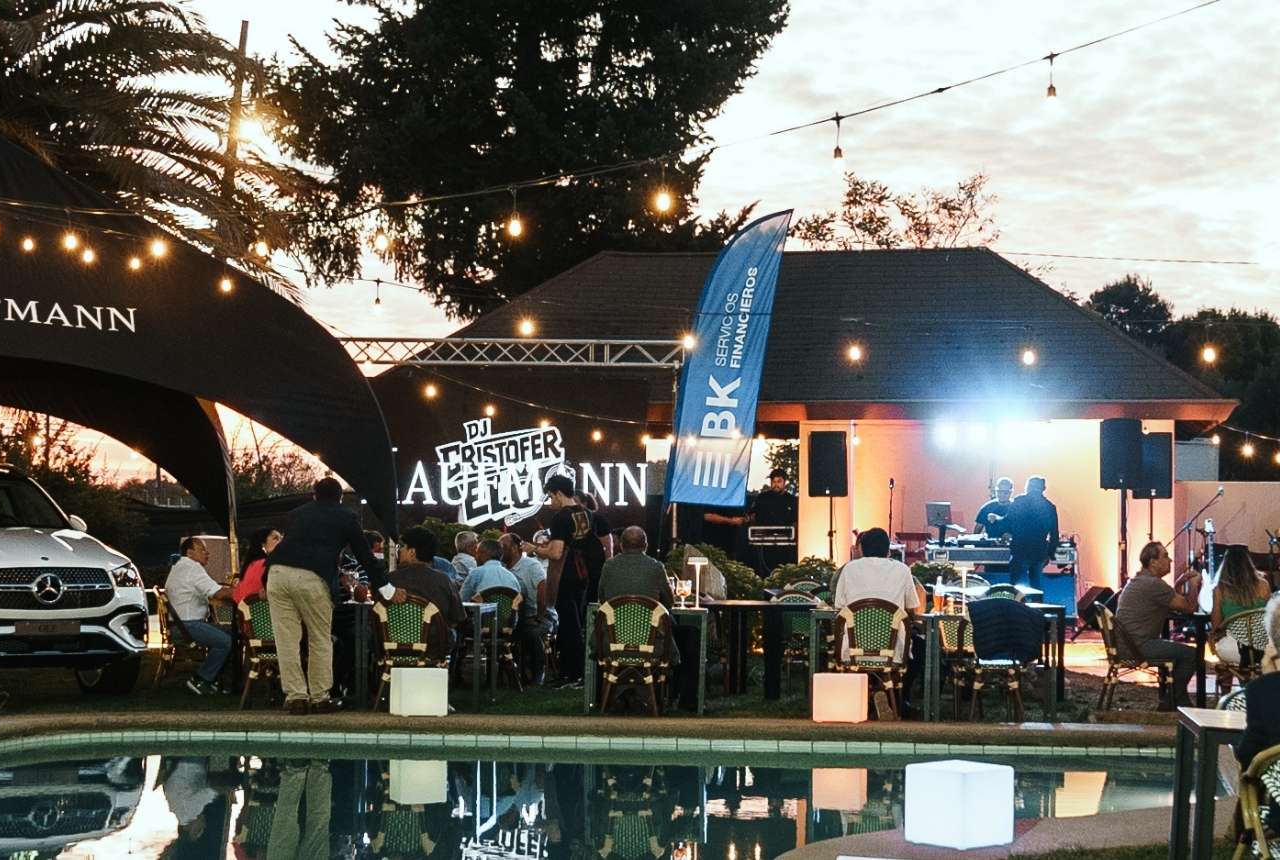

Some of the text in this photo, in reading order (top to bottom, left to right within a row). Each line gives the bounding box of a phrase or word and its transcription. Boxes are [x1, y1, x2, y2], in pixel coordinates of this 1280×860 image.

[715, 292, 739, 367] SERVICOS
[730, 266, 758, 369] FINANCIEROS
[466, 420, 489, 440] DJ
[701, 373, 742, 438] BK
[396, 460, 648, 506] AUFMNN
